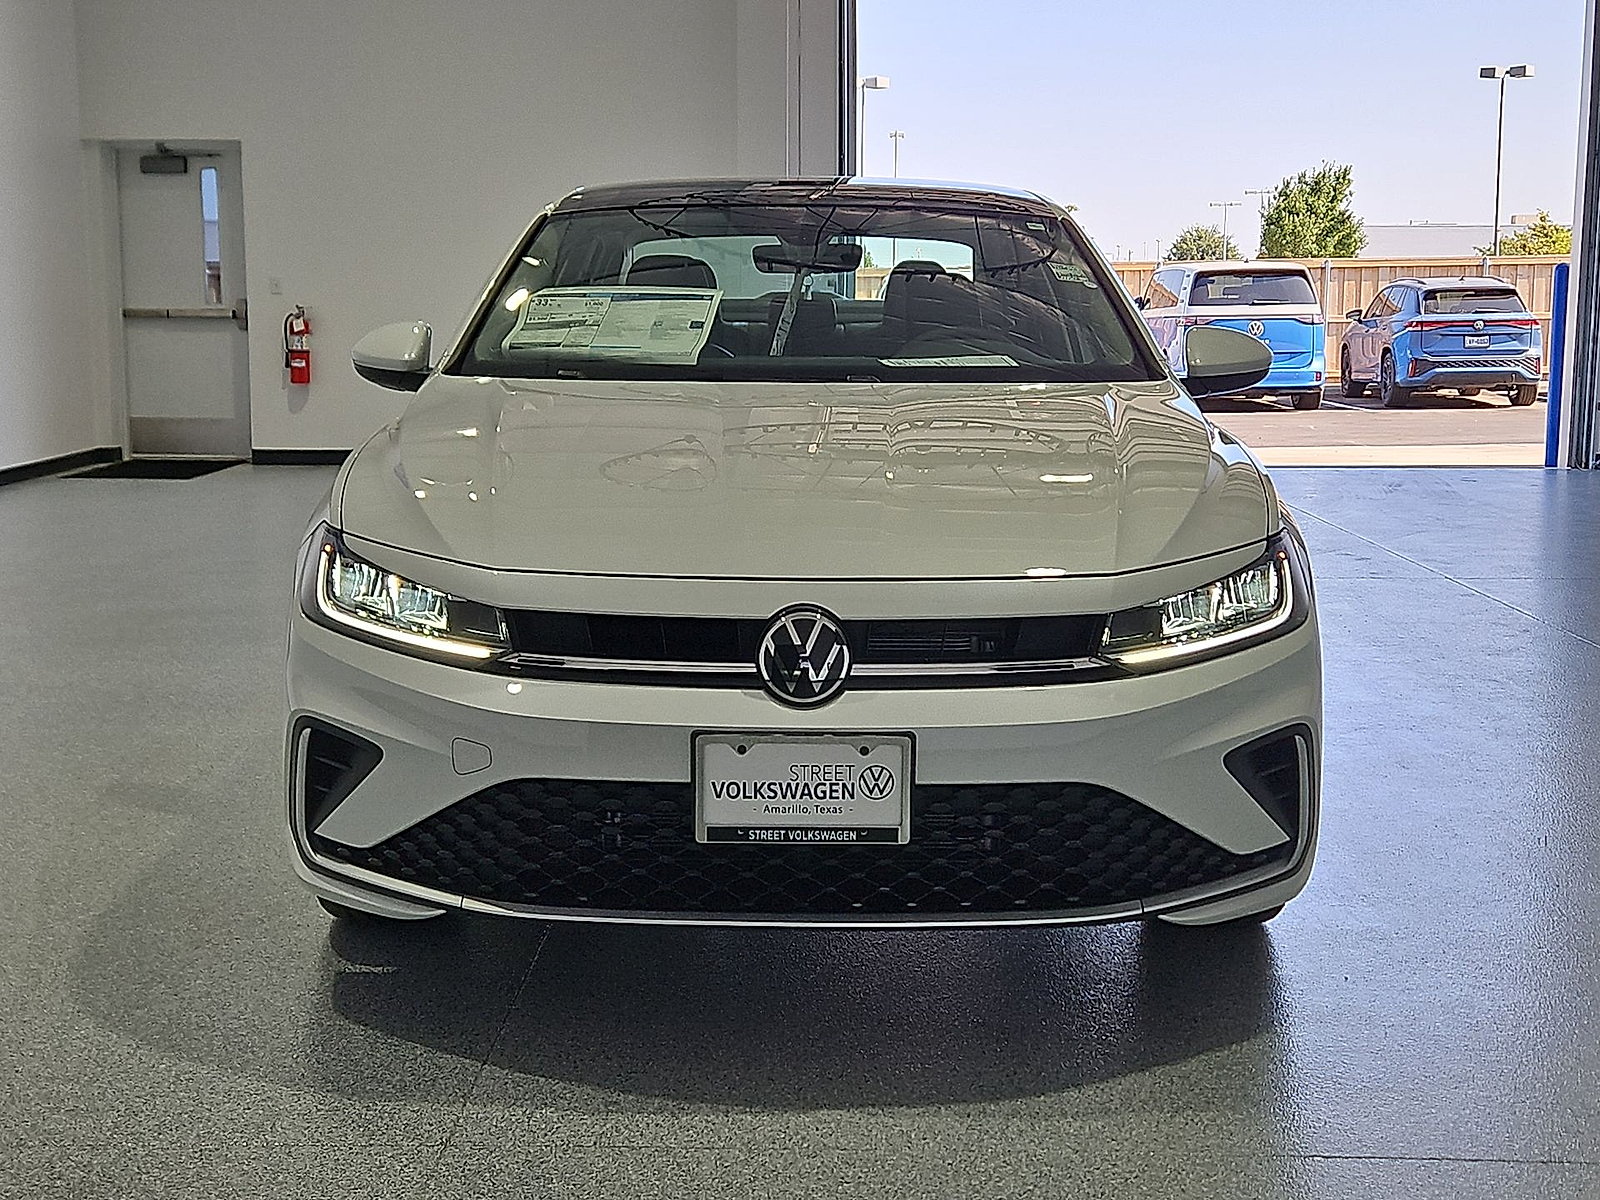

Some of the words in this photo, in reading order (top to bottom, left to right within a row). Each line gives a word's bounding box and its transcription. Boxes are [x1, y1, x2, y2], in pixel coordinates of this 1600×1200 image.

[789, 764, 856, 782] STREET
[711, 781, 855, 801] VOLKSWAGEN
[763, 804, 812, 815] Amarillo,
[814, 804, 843, 814] Texas
[749, 830, 785, 840] STREET
[788, 830, 857, 841] VOLKSWAGEN
